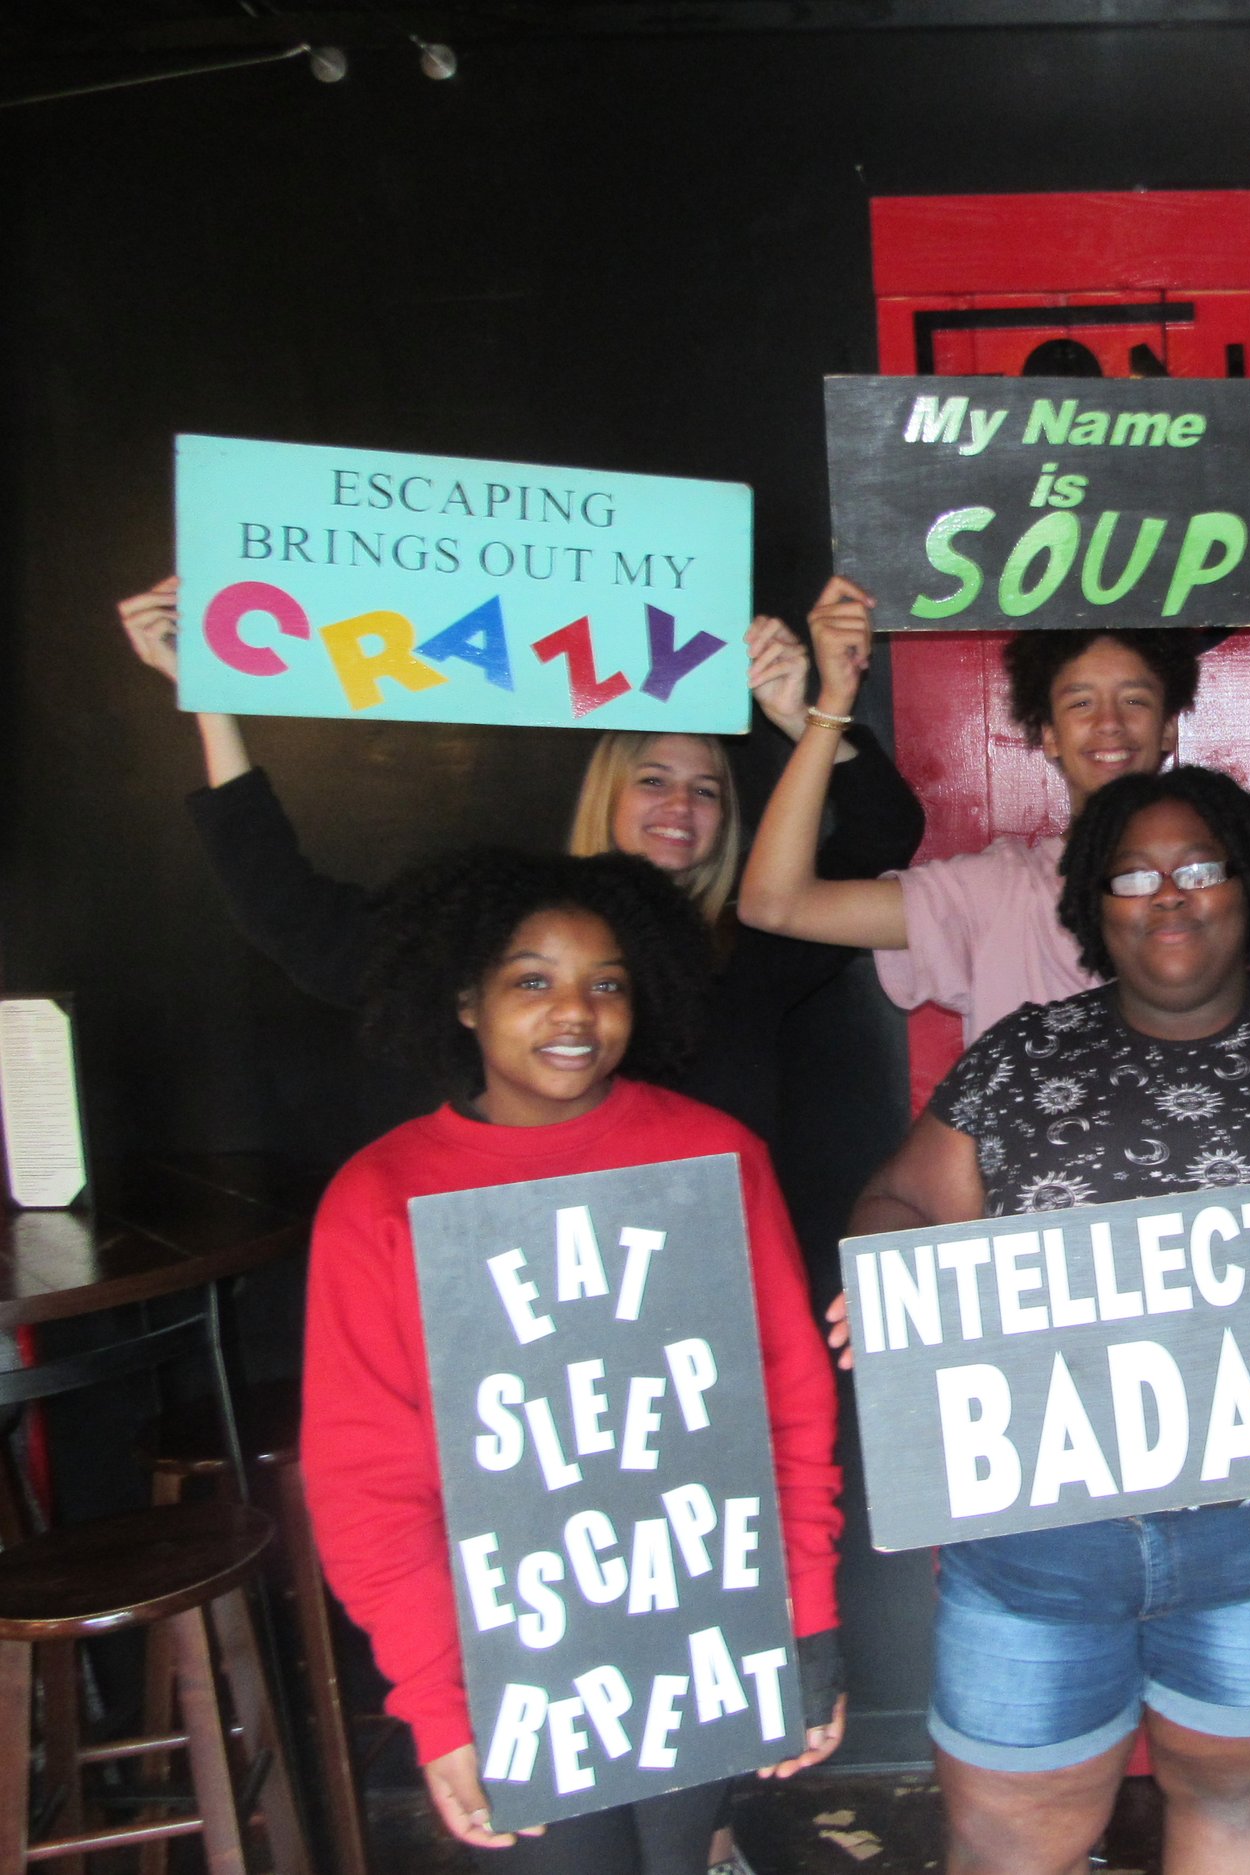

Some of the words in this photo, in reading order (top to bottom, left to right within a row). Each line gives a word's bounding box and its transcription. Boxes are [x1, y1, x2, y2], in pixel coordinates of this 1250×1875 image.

[904, 396, 1009, 456] My
[1022, 398, 1207, 448] Name
[1029, 462, 1090, 508] is
[238, 521, 460, 574] BRINGS
[479, 540, 593, 582] OUT
[613, 551, 695, 590] MY
[330, 468, 616, 528] ESCAPING
[909, 506, 1248, 619] SOUP
[202, 581, 728, 719] CRAZY
[487, 1205, 667, 1345] EAT
[475, 1338, 719, 1491] SLEEP
[458, 1482, 760, 1650] ESCAPE
[483, 1625, 788, 1795] REPEAT
